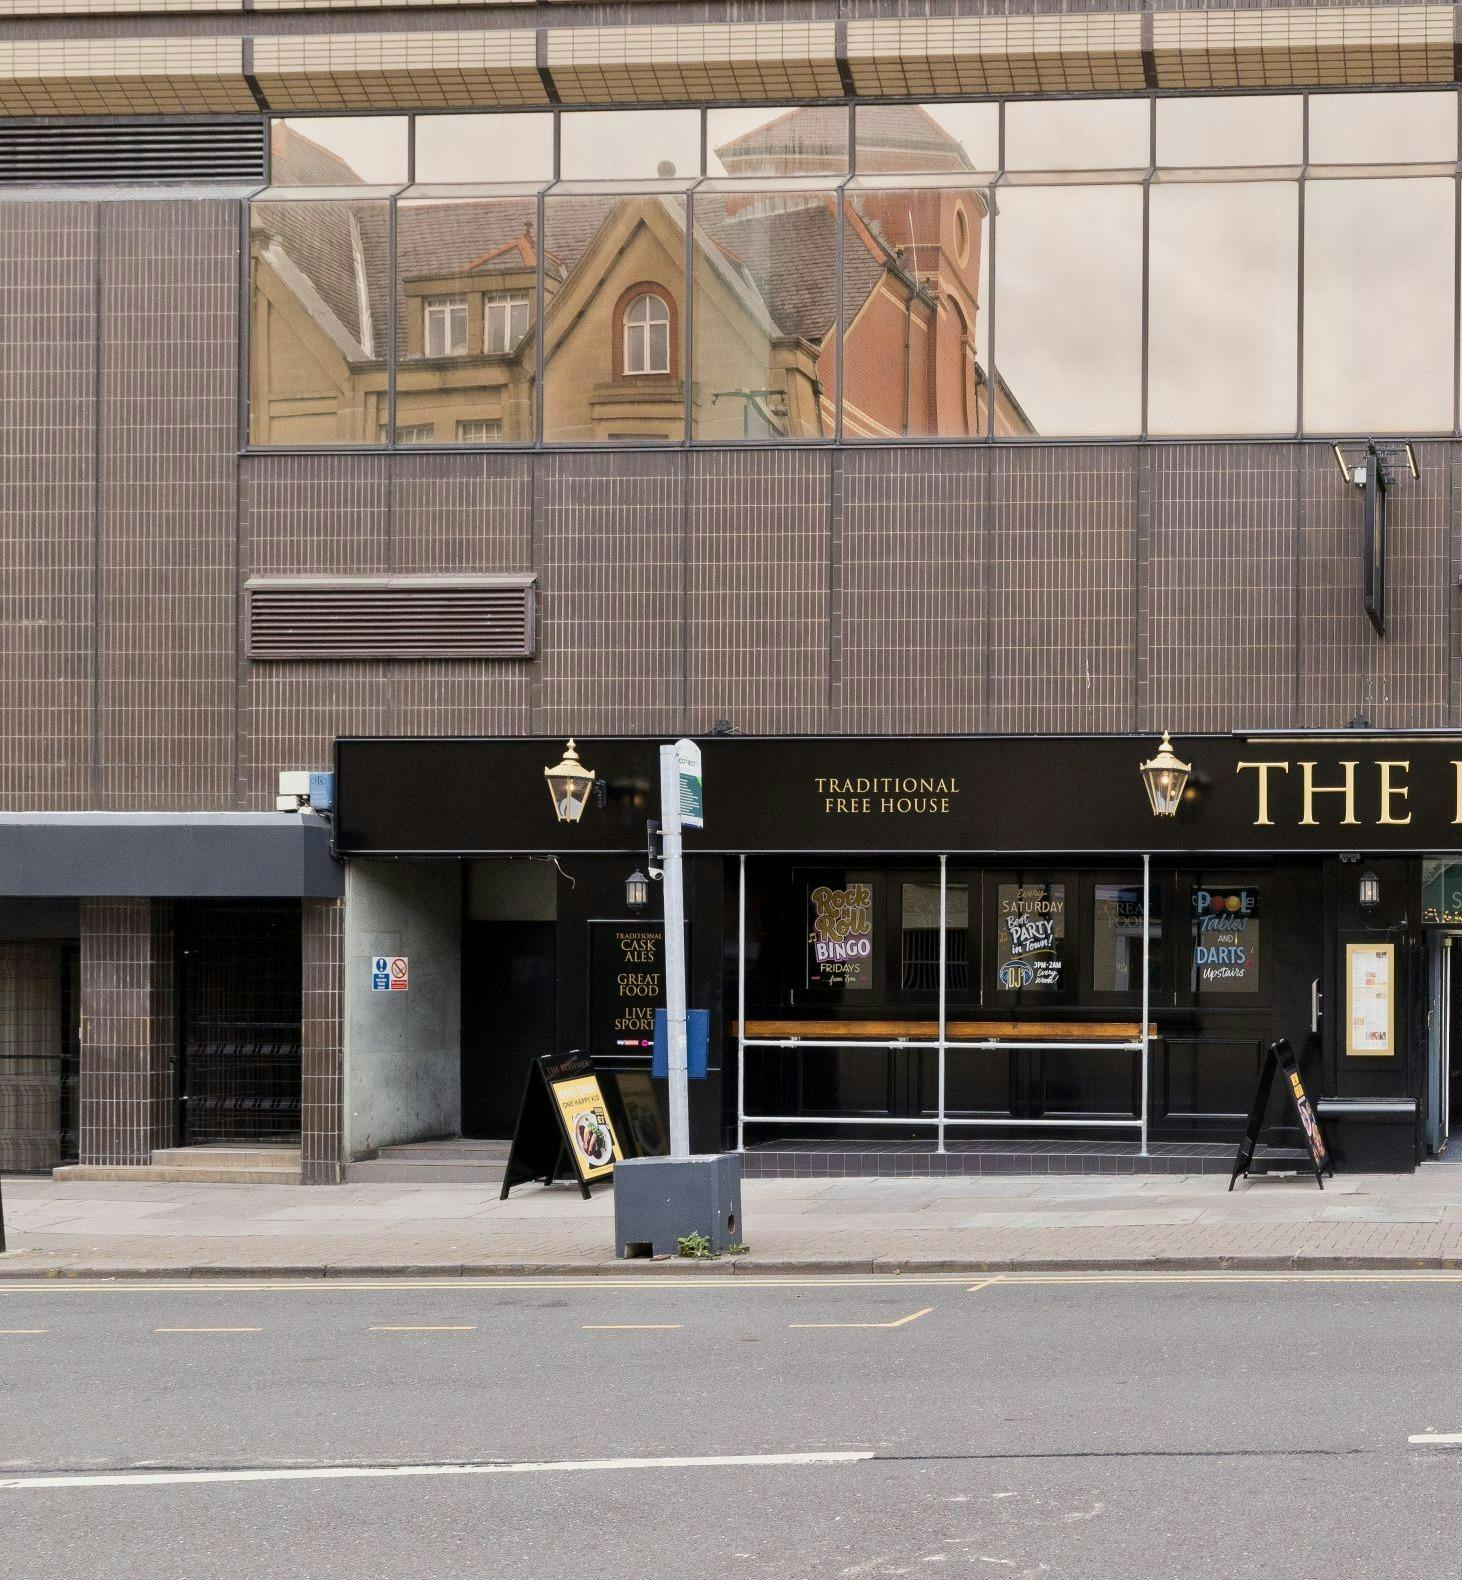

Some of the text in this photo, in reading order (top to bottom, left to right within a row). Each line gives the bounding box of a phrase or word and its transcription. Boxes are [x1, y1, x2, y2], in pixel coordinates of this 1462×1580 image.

[815, 777, 960, 793] TRADITIONAL
[1236, 760, 1413, 825] THE
[825, 798, 950, 813] FREE HOUSE
[812, 884, 872, 919] Rock
[1002, 900, 1065, 913] SATURDAY
[815, 906, 872, 943] Roll
[1006, 913, 1030, 928] Best
[1200, 914, 1249, 933] Tables
[616, 932, 664, 940] TRADITIONAL
[1010, 920, 1054, 944] PARTY
[1217, 934, 1234, 943] AND
[621, 940, 656, 951] CASK
[816, 939, 871, 961] BINGO
[1011, 934, 1054, 955] in Town!
[624, 951, 654, 962] ALES
[1196, 946, 1246, 964] DARTS
[820, 963, 861, 973] FRIDAYS
[1203, 967, 1245, 982] Upstairs
[617, 973, 661, 985] GREAT
[619, 985, 659, 996] FOOD
[625, 1007, 653, 1019] LIVE
[574, 1097, 591, 1106] HAPPY
